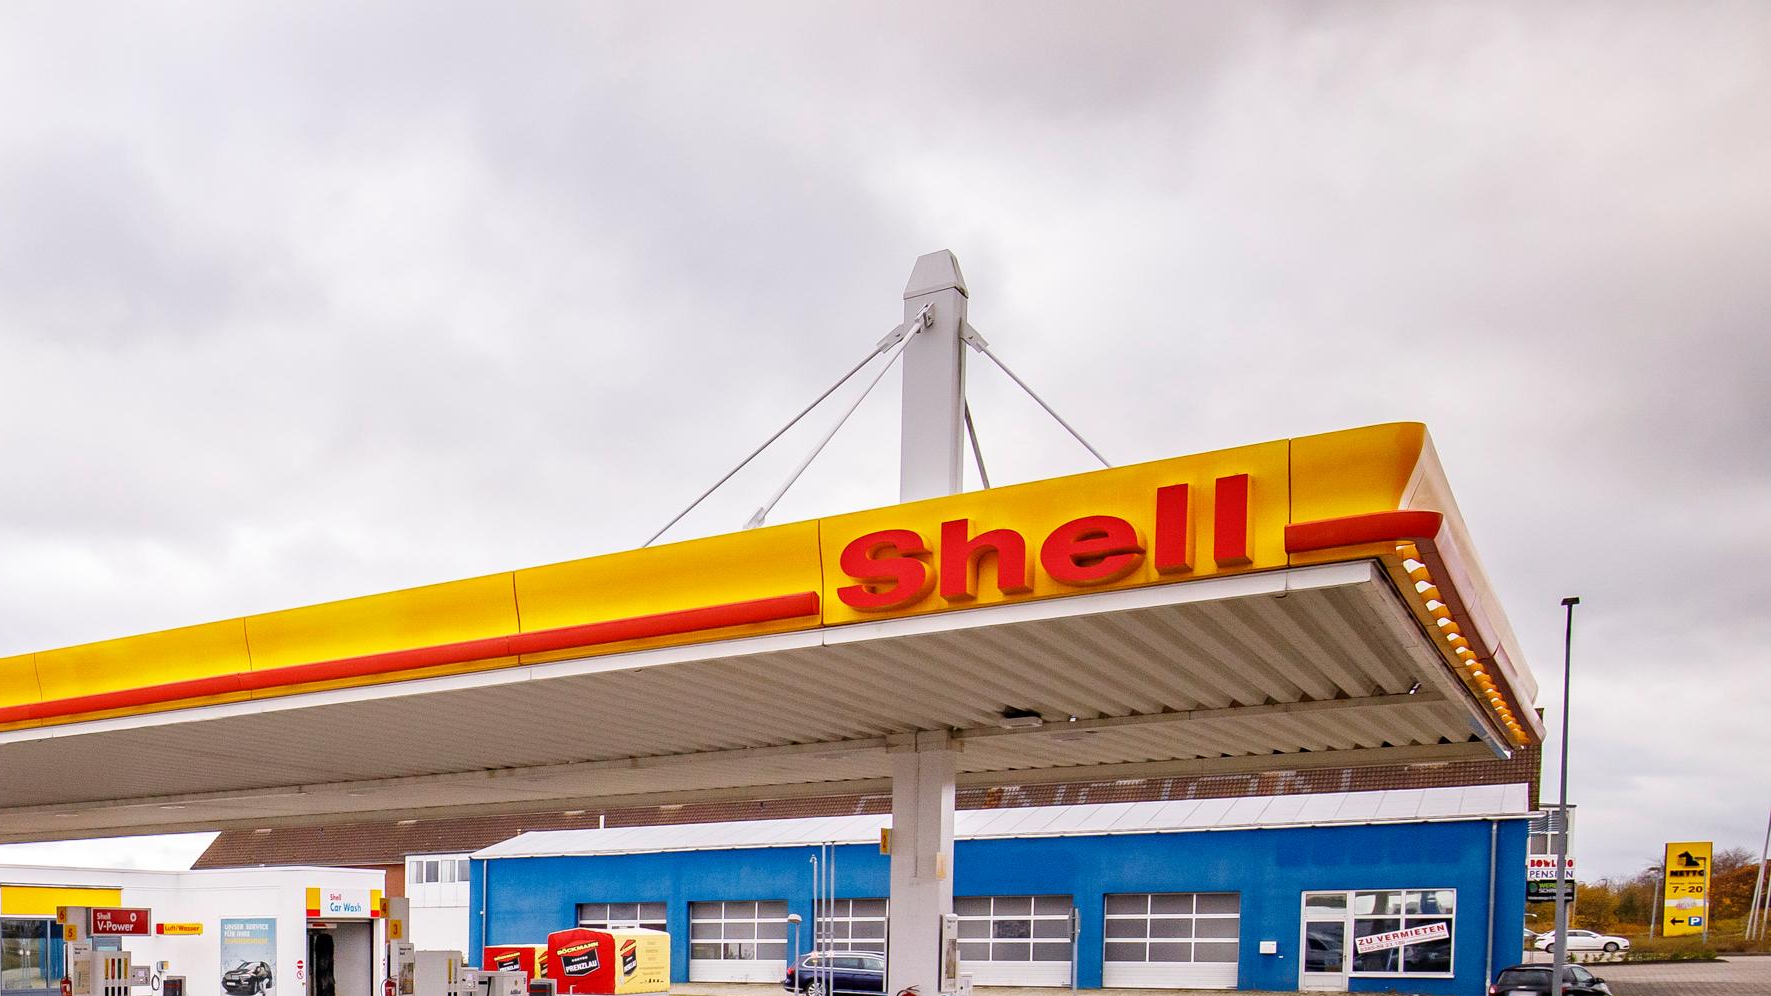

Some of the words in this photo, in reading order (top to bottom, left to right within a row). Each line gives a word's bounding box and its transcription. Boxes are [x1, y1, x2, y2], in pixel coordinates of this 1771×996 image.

[837, 473, 1254, 612] Shell
[1530, 859, 1574, 868] BOWLG
[1529, 870, 1573, 878] PENSIN
[330, 902, 342, 912] Car
[344, 902, 362, 912] Wash
[382, 902, 387, 914] 4
[59, 911, 64, 920] 6
[96, 912, 111, 920] Shell
[97, 921, 134, 932] V-Power
[393, 924, 398, 935] 3
[68, 928, 73, 937] 5
[1358, 938, 1373, 946] ZU
[1377, 924, 1444, 942] VERMIETEN
[556, 941, 599, 956] BÖCKMANN
[565, 960, 598, 973] PRENZLAU
